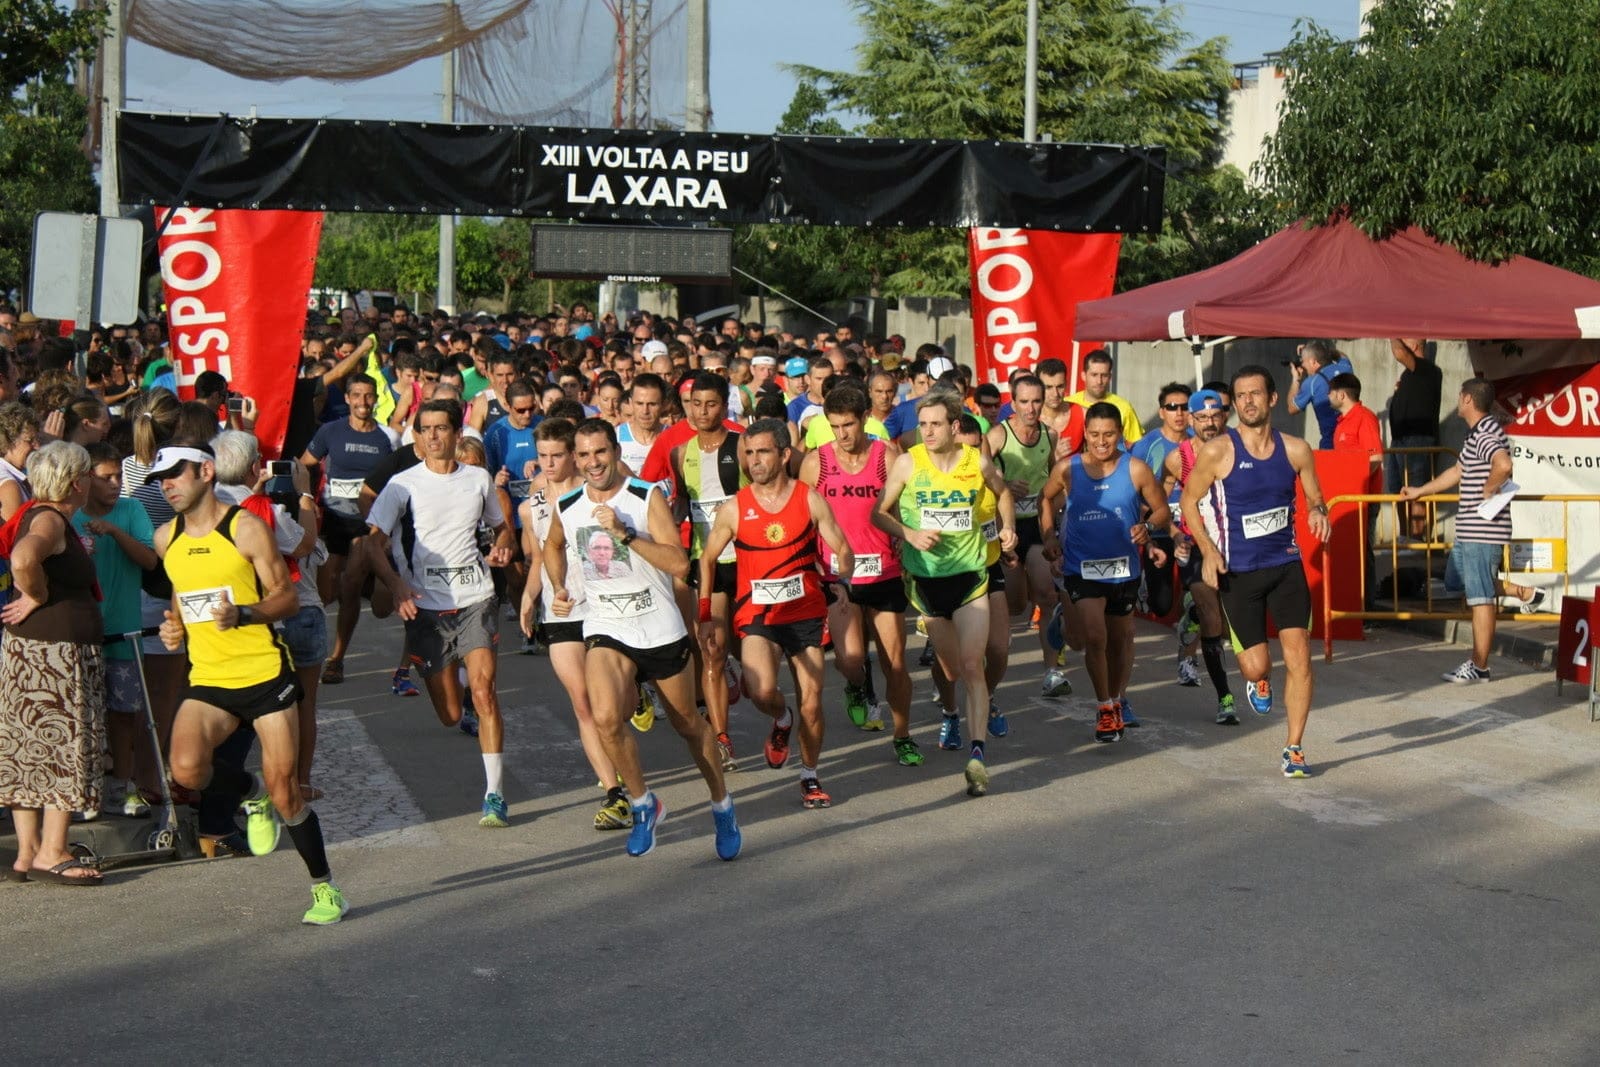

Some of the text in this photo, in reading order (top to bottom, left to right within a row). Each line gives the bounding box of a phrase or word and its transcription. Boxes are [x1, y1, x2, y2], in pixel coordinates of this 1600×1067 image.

[541, 144, 749, 173] XIII VOLTA A PEU
[567, 173, 728, 209] LA XARA
[824, 483, 837, 497] la
[954, 518, 970, 528] 490
[460, 574, 474, 585] 851
[786, 586, 801, 597] 868
[635, 597, 652, 611] 630
[1573, 619, 1589, 667] 2
